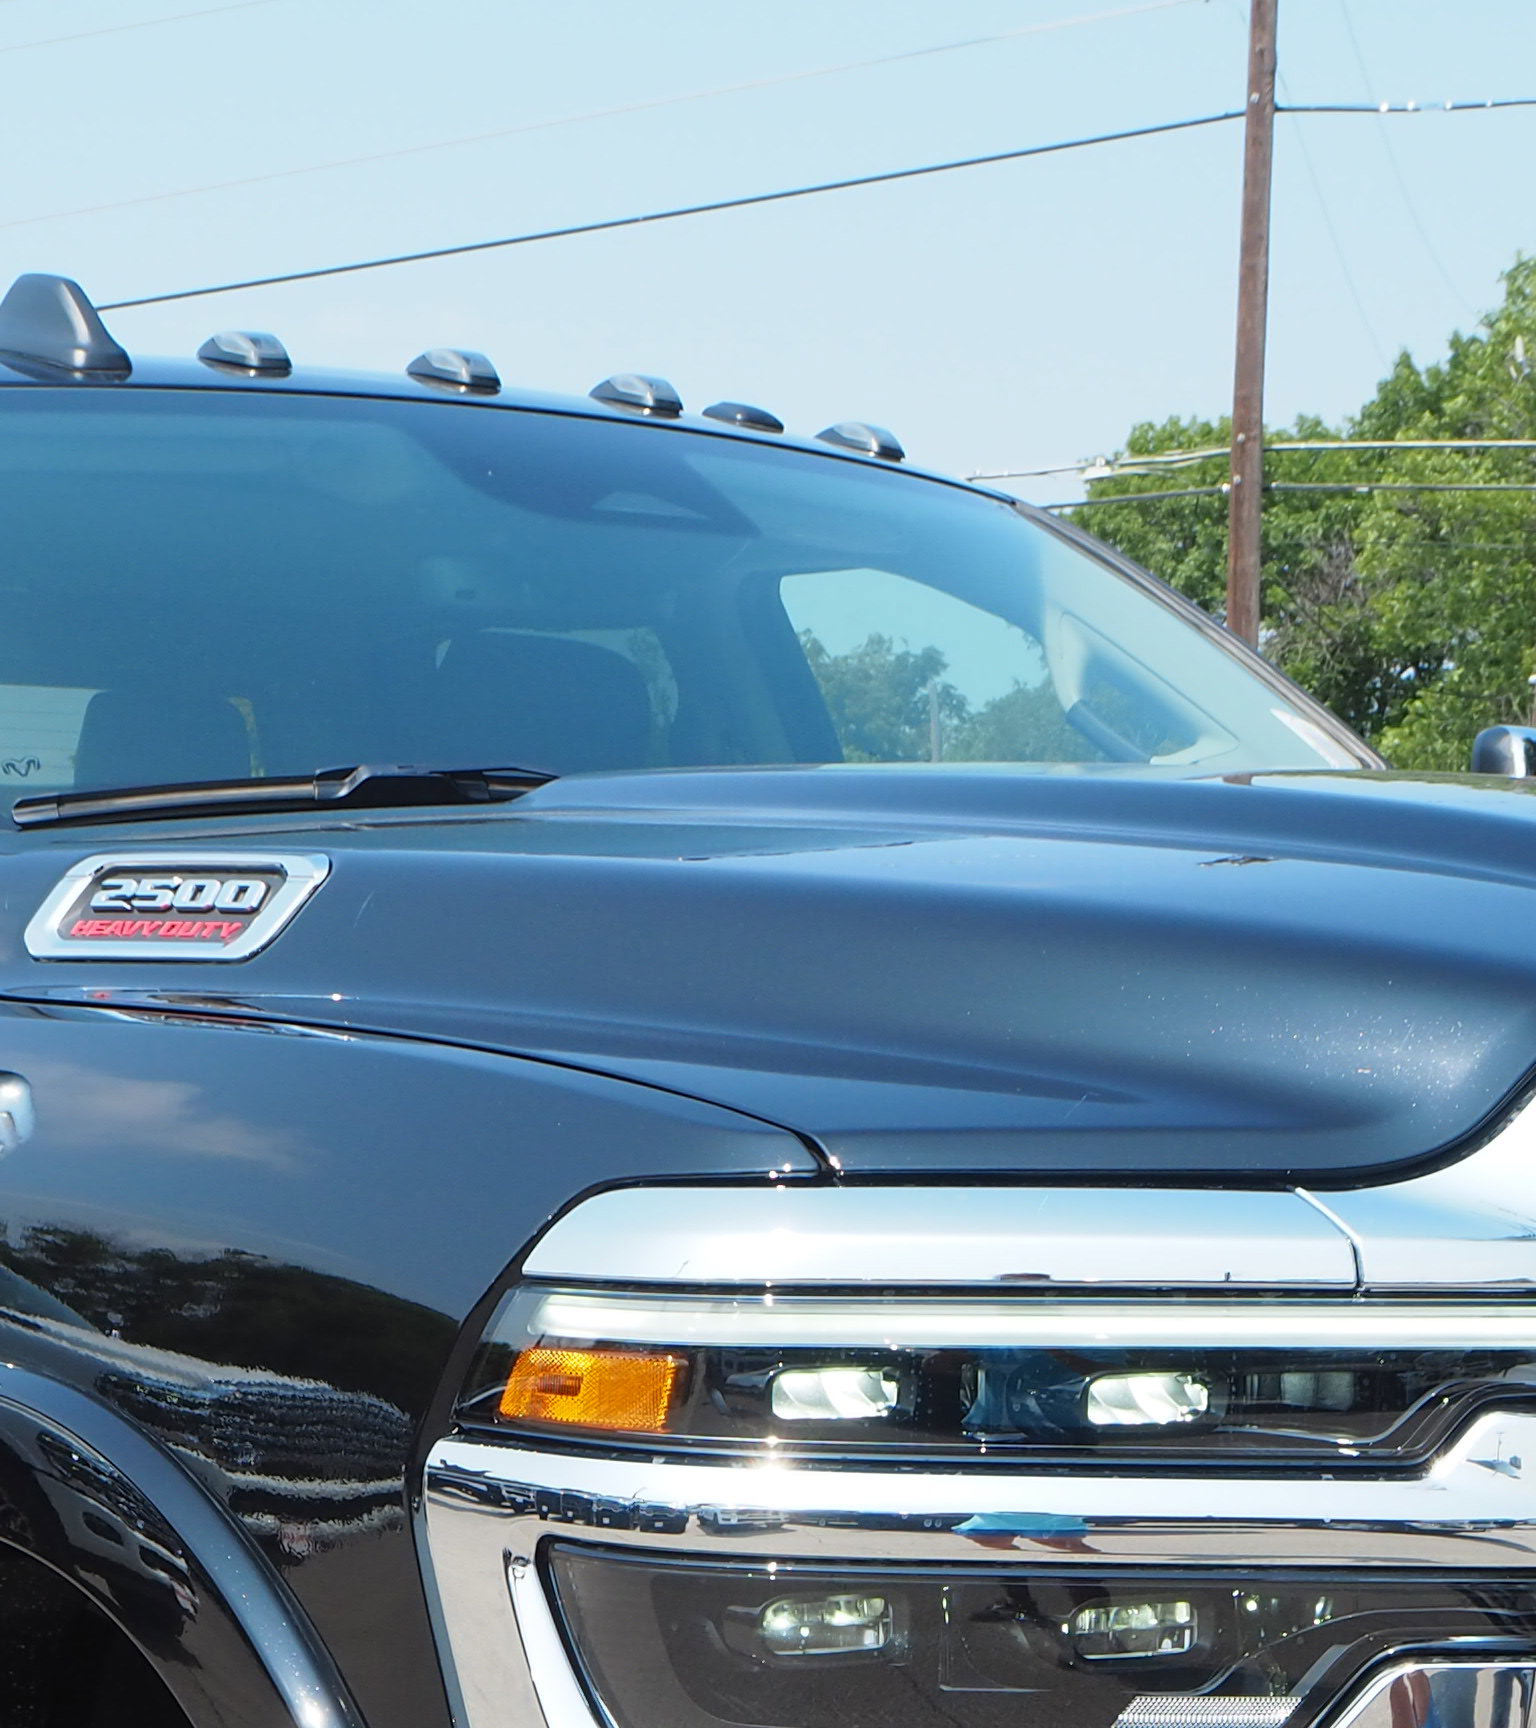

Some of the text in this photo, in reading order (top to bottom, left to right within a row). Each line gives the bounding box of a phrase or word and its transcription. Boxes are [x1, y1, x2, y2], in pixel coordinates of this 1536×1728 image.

[90, 879, 269, 913] 2500
[70, 920, 243, 939] HEAVY DUTY
